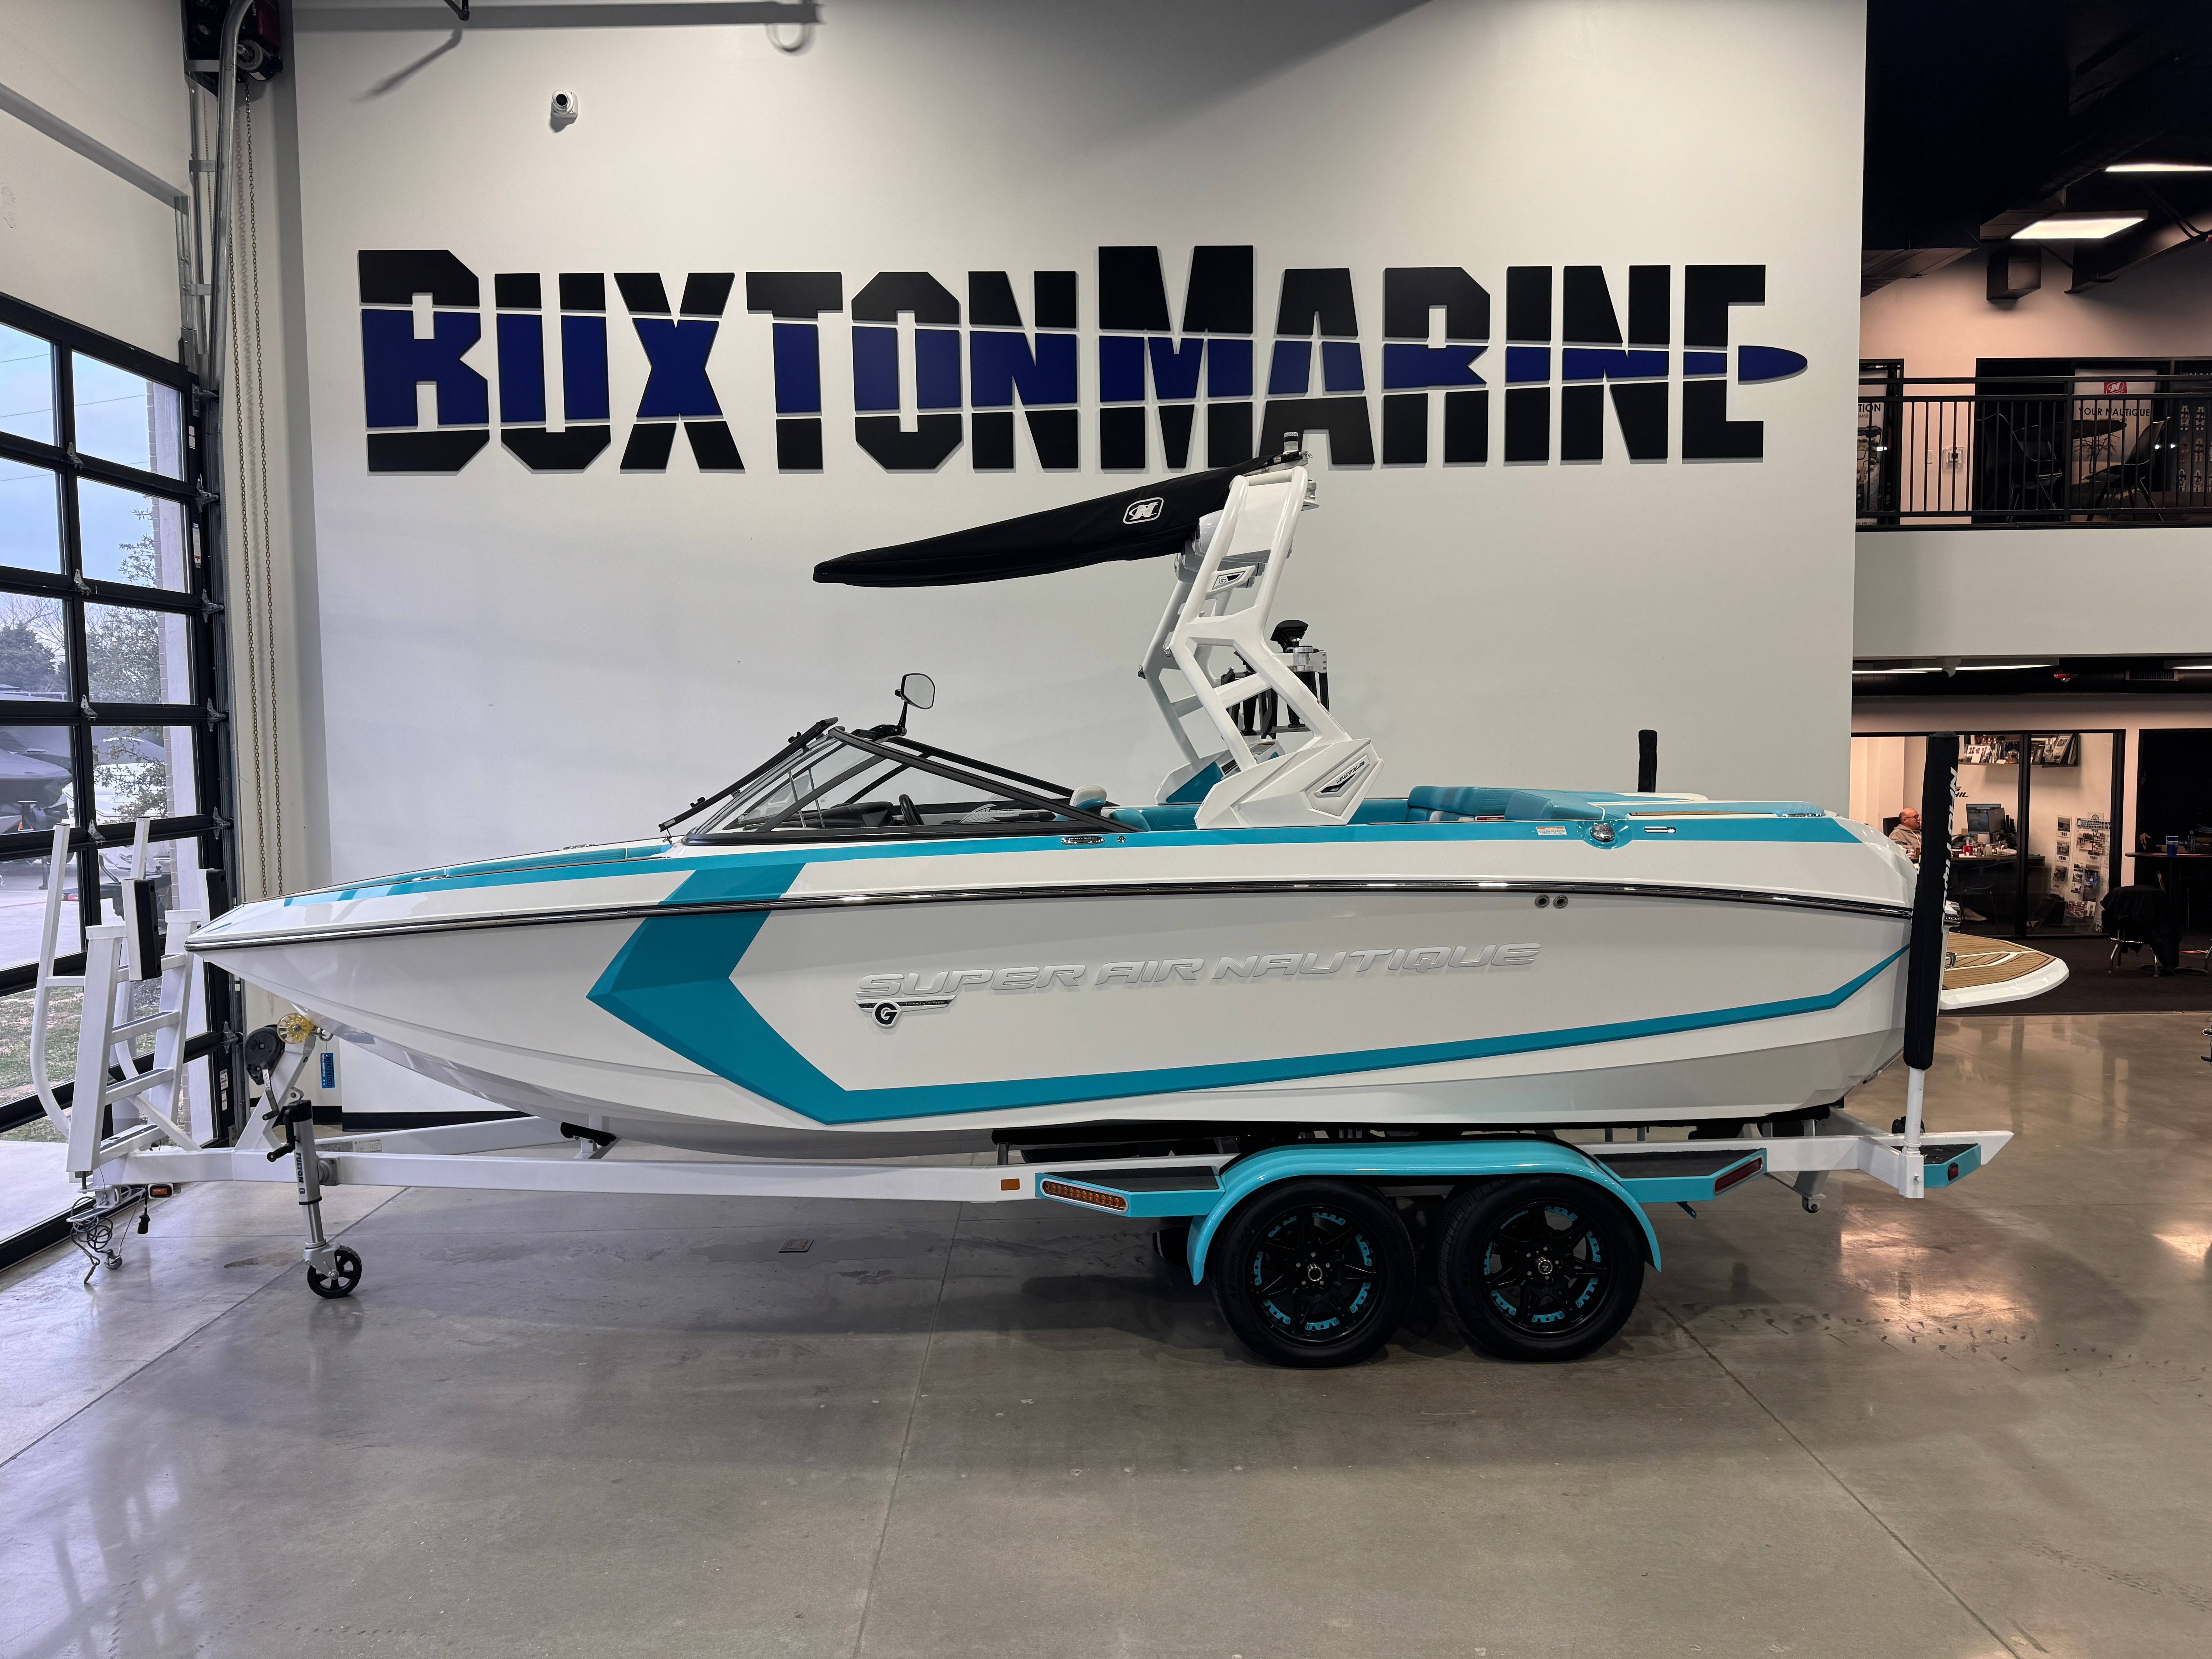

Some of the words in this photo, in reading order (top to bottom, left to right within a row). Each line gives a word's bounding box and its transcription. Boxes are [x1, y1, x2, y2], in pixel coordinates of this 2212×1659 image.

[856, 964, 1085, 998] SUPER
[1096, 958, 1204, 985] AIR
[1212, 943, 1541, 979] NAUTIQUE
[295, 1152, 304, 1183] FULTON
